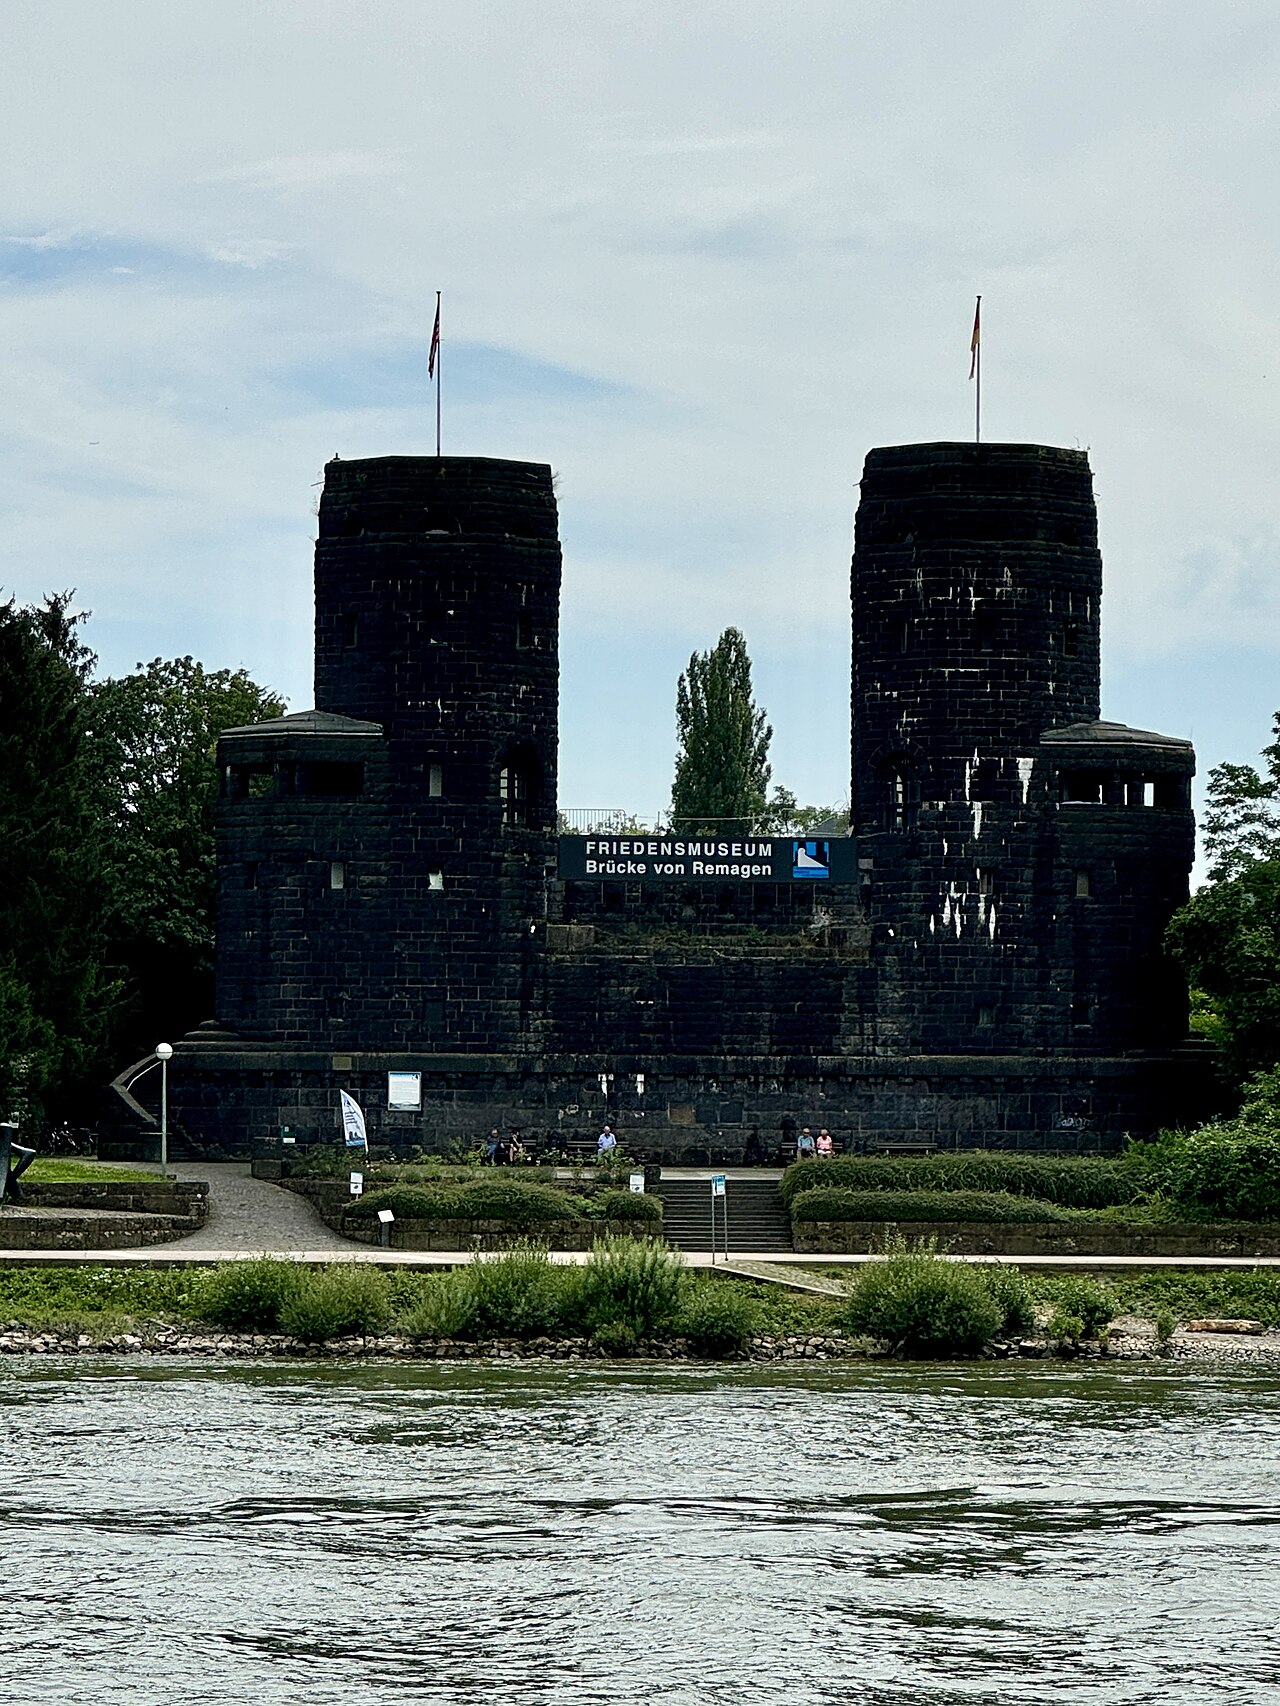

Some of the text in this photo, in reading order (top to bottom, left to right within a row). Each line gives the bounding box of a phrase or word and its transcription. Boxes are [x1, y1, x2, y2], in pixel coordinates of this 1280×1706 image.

[586, 841, 772, 857] FRIEDENSMUSEUM
[586, 860, 772, 878] Brücke von Remagen
